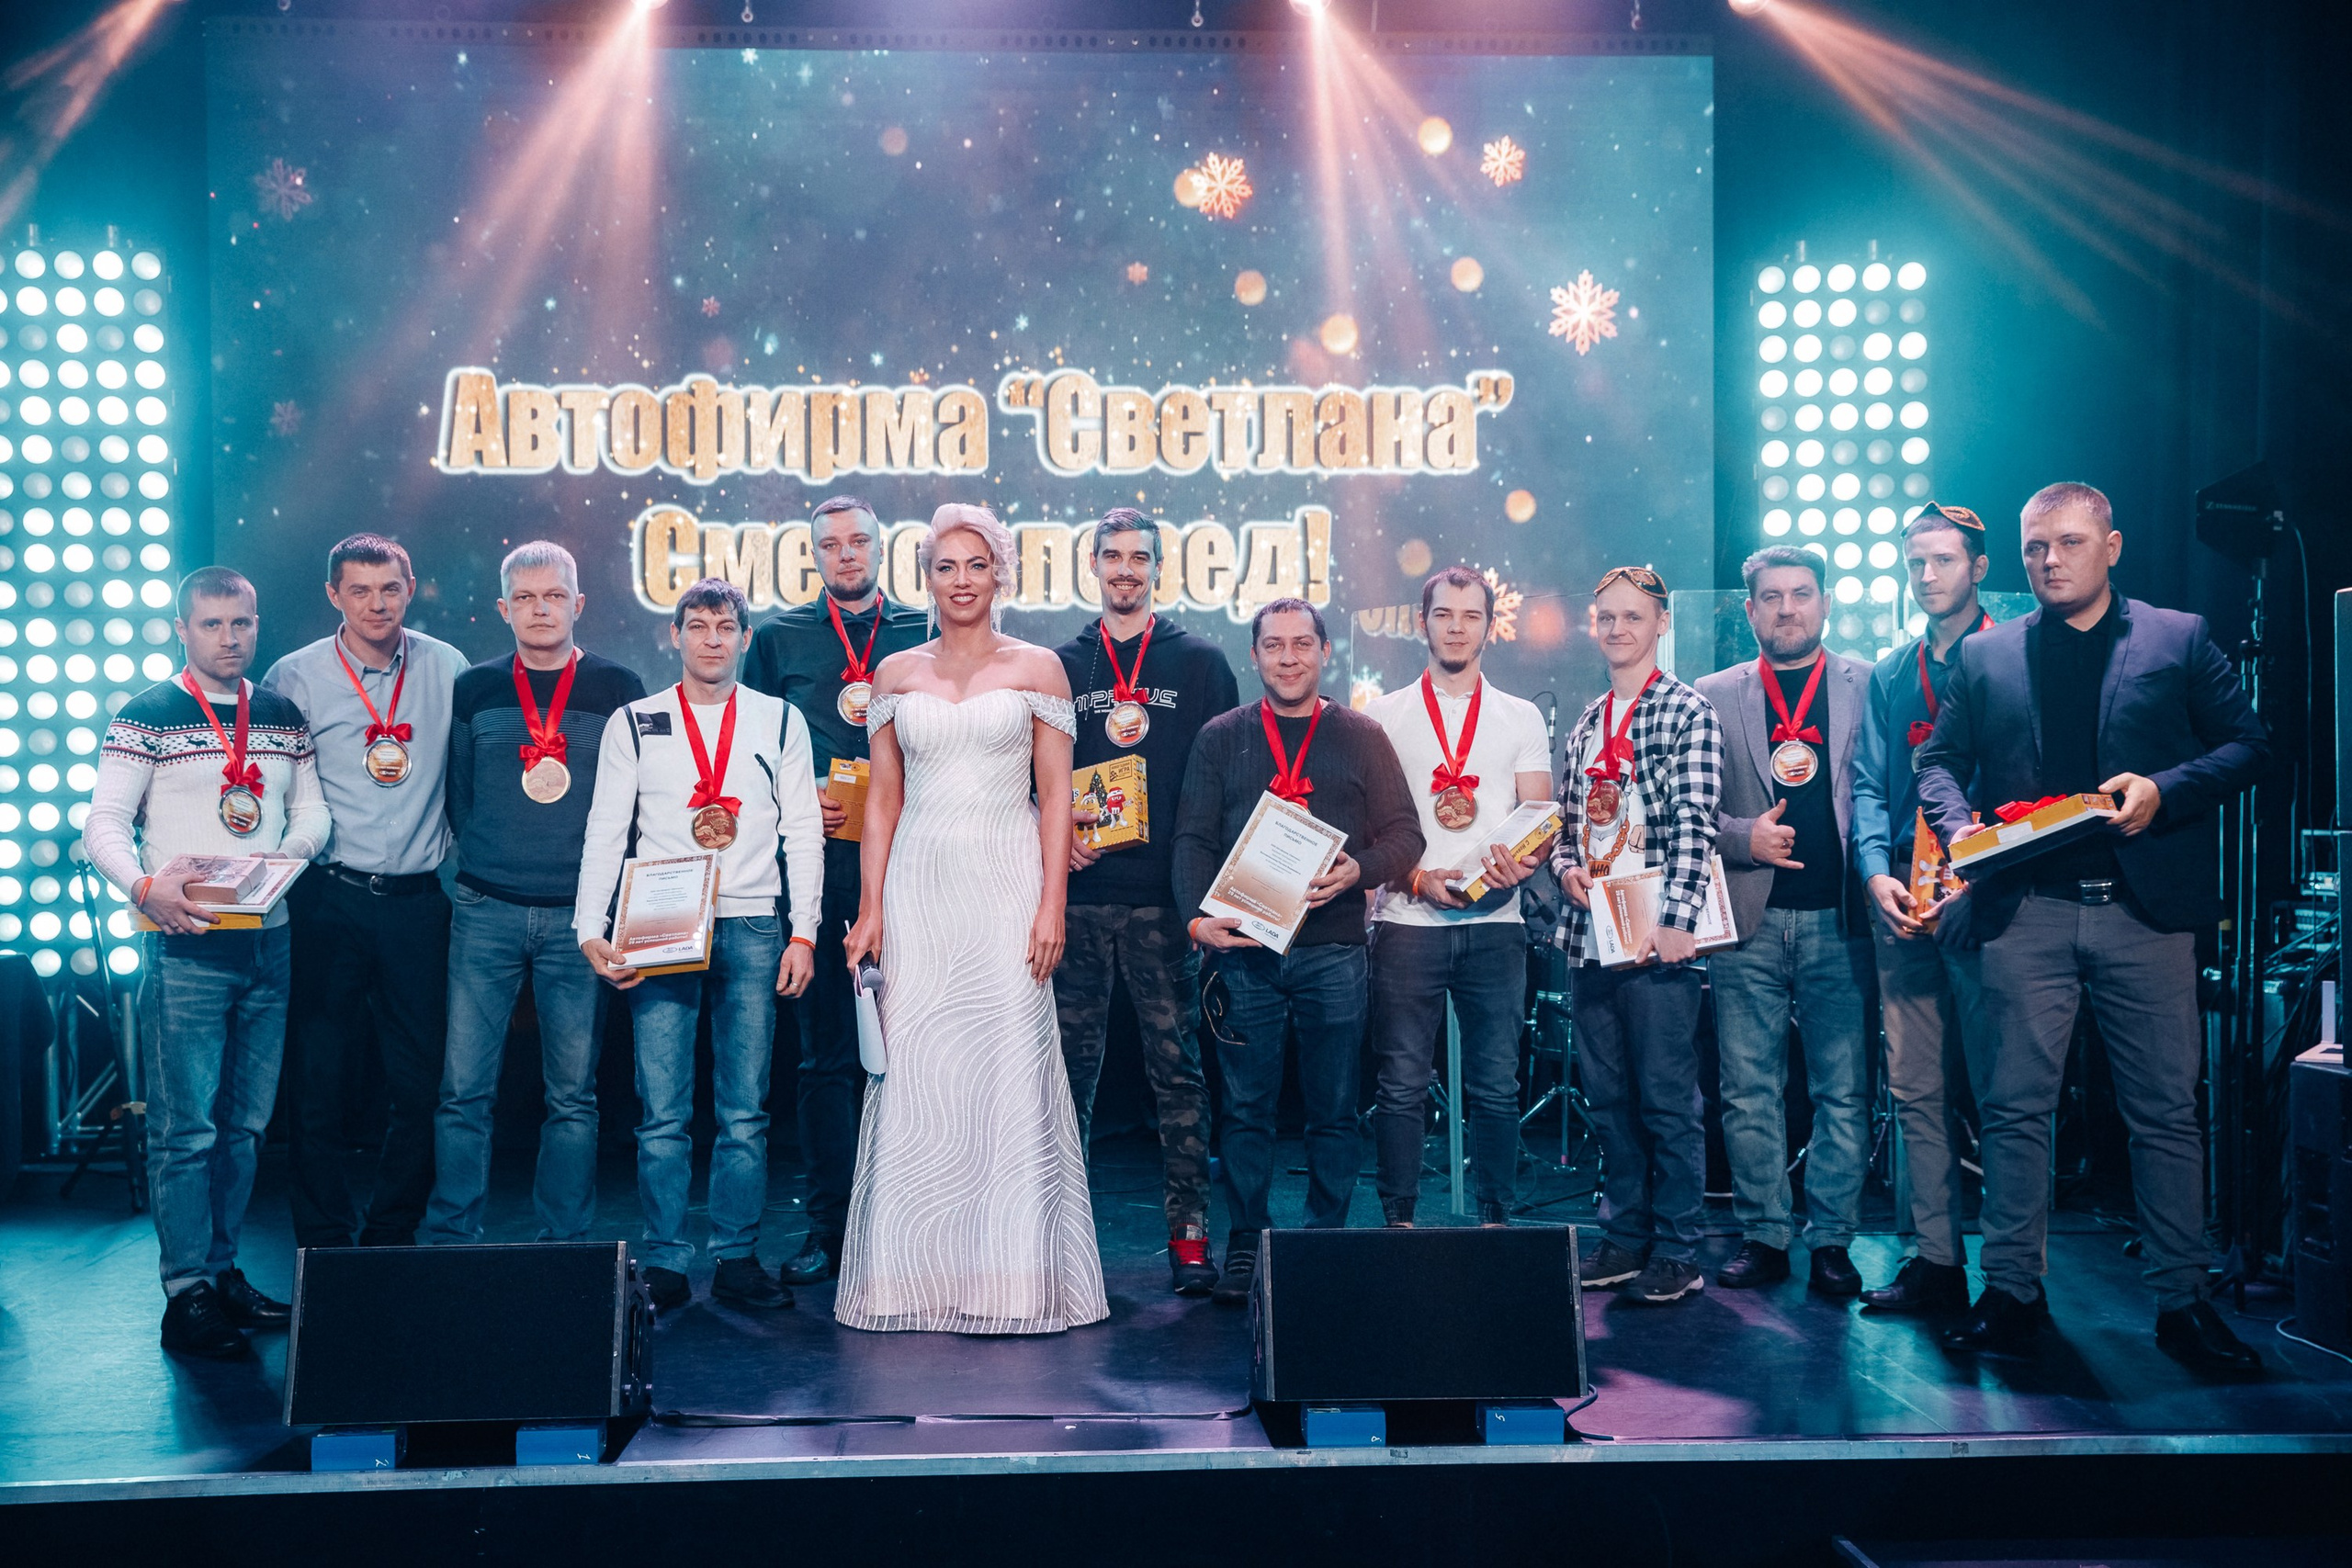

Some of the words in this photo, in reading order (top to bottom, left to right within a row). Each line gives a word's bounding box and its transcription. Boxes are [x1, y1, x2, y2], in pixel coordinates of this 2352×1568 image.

[447, 372, 989, 480] Автофирма
[644, 511, 930, 607] Смео
[1265, 928, 1279, 938] LADA
